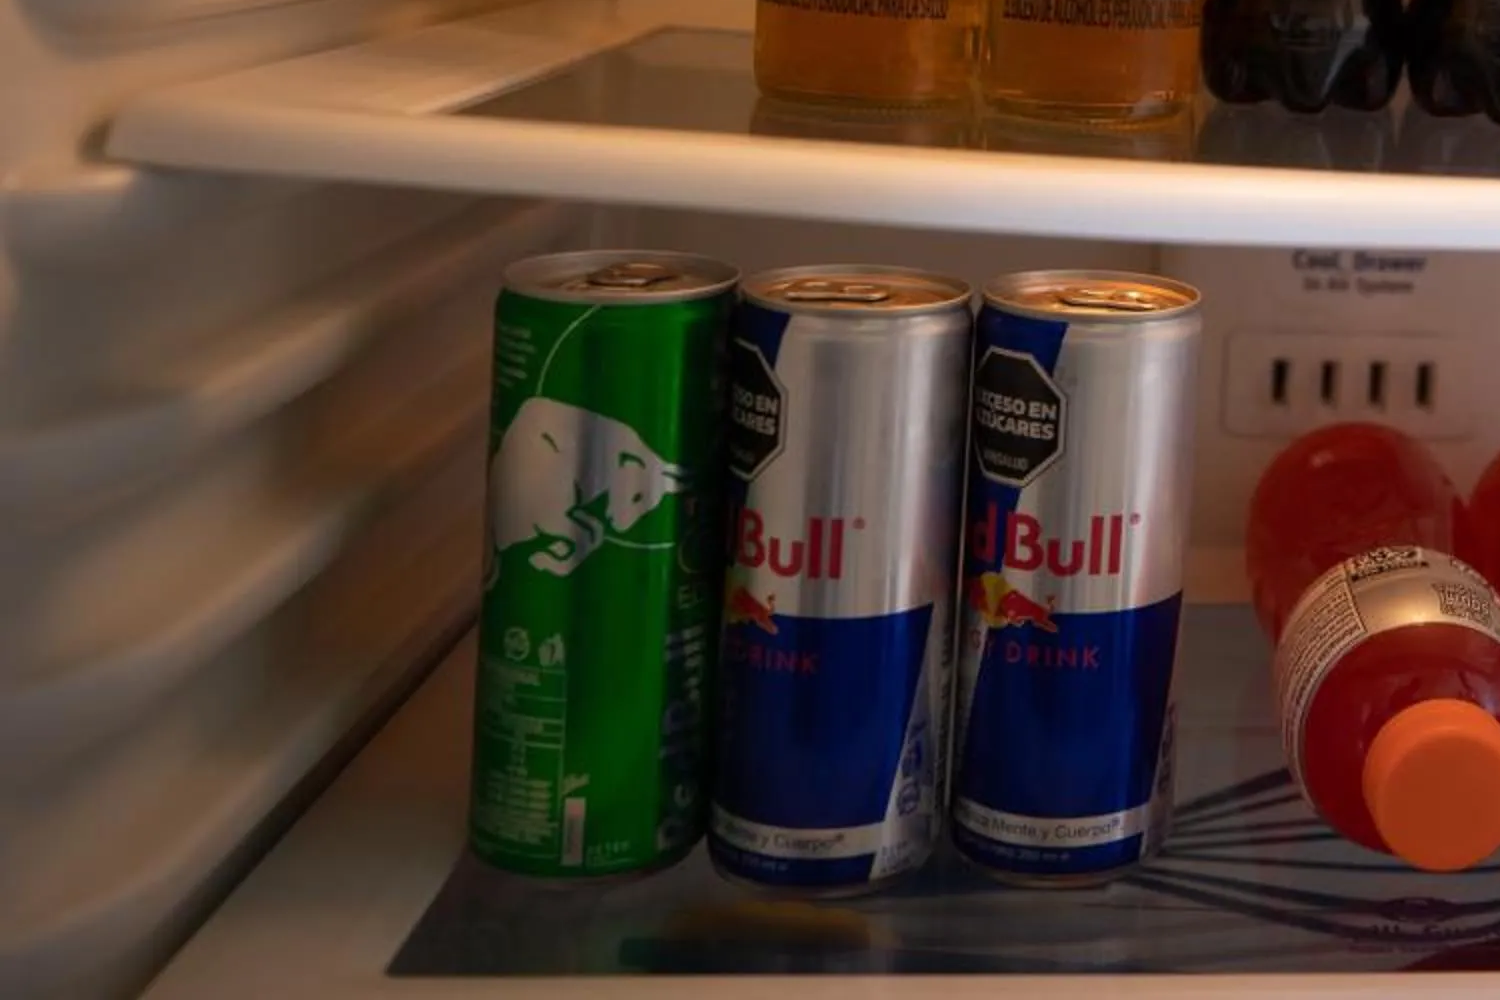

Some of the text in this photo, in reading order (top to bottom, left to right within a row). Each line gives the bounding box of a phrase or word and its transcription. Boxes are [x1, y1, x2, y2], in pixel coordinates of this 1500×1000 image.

[755, 394, 779, 416] EN
[1029, 401, 1057, 421] EN
[1004, 510, 1123, 577] Bull
[1004, 641, 1100, 670] DRINK
